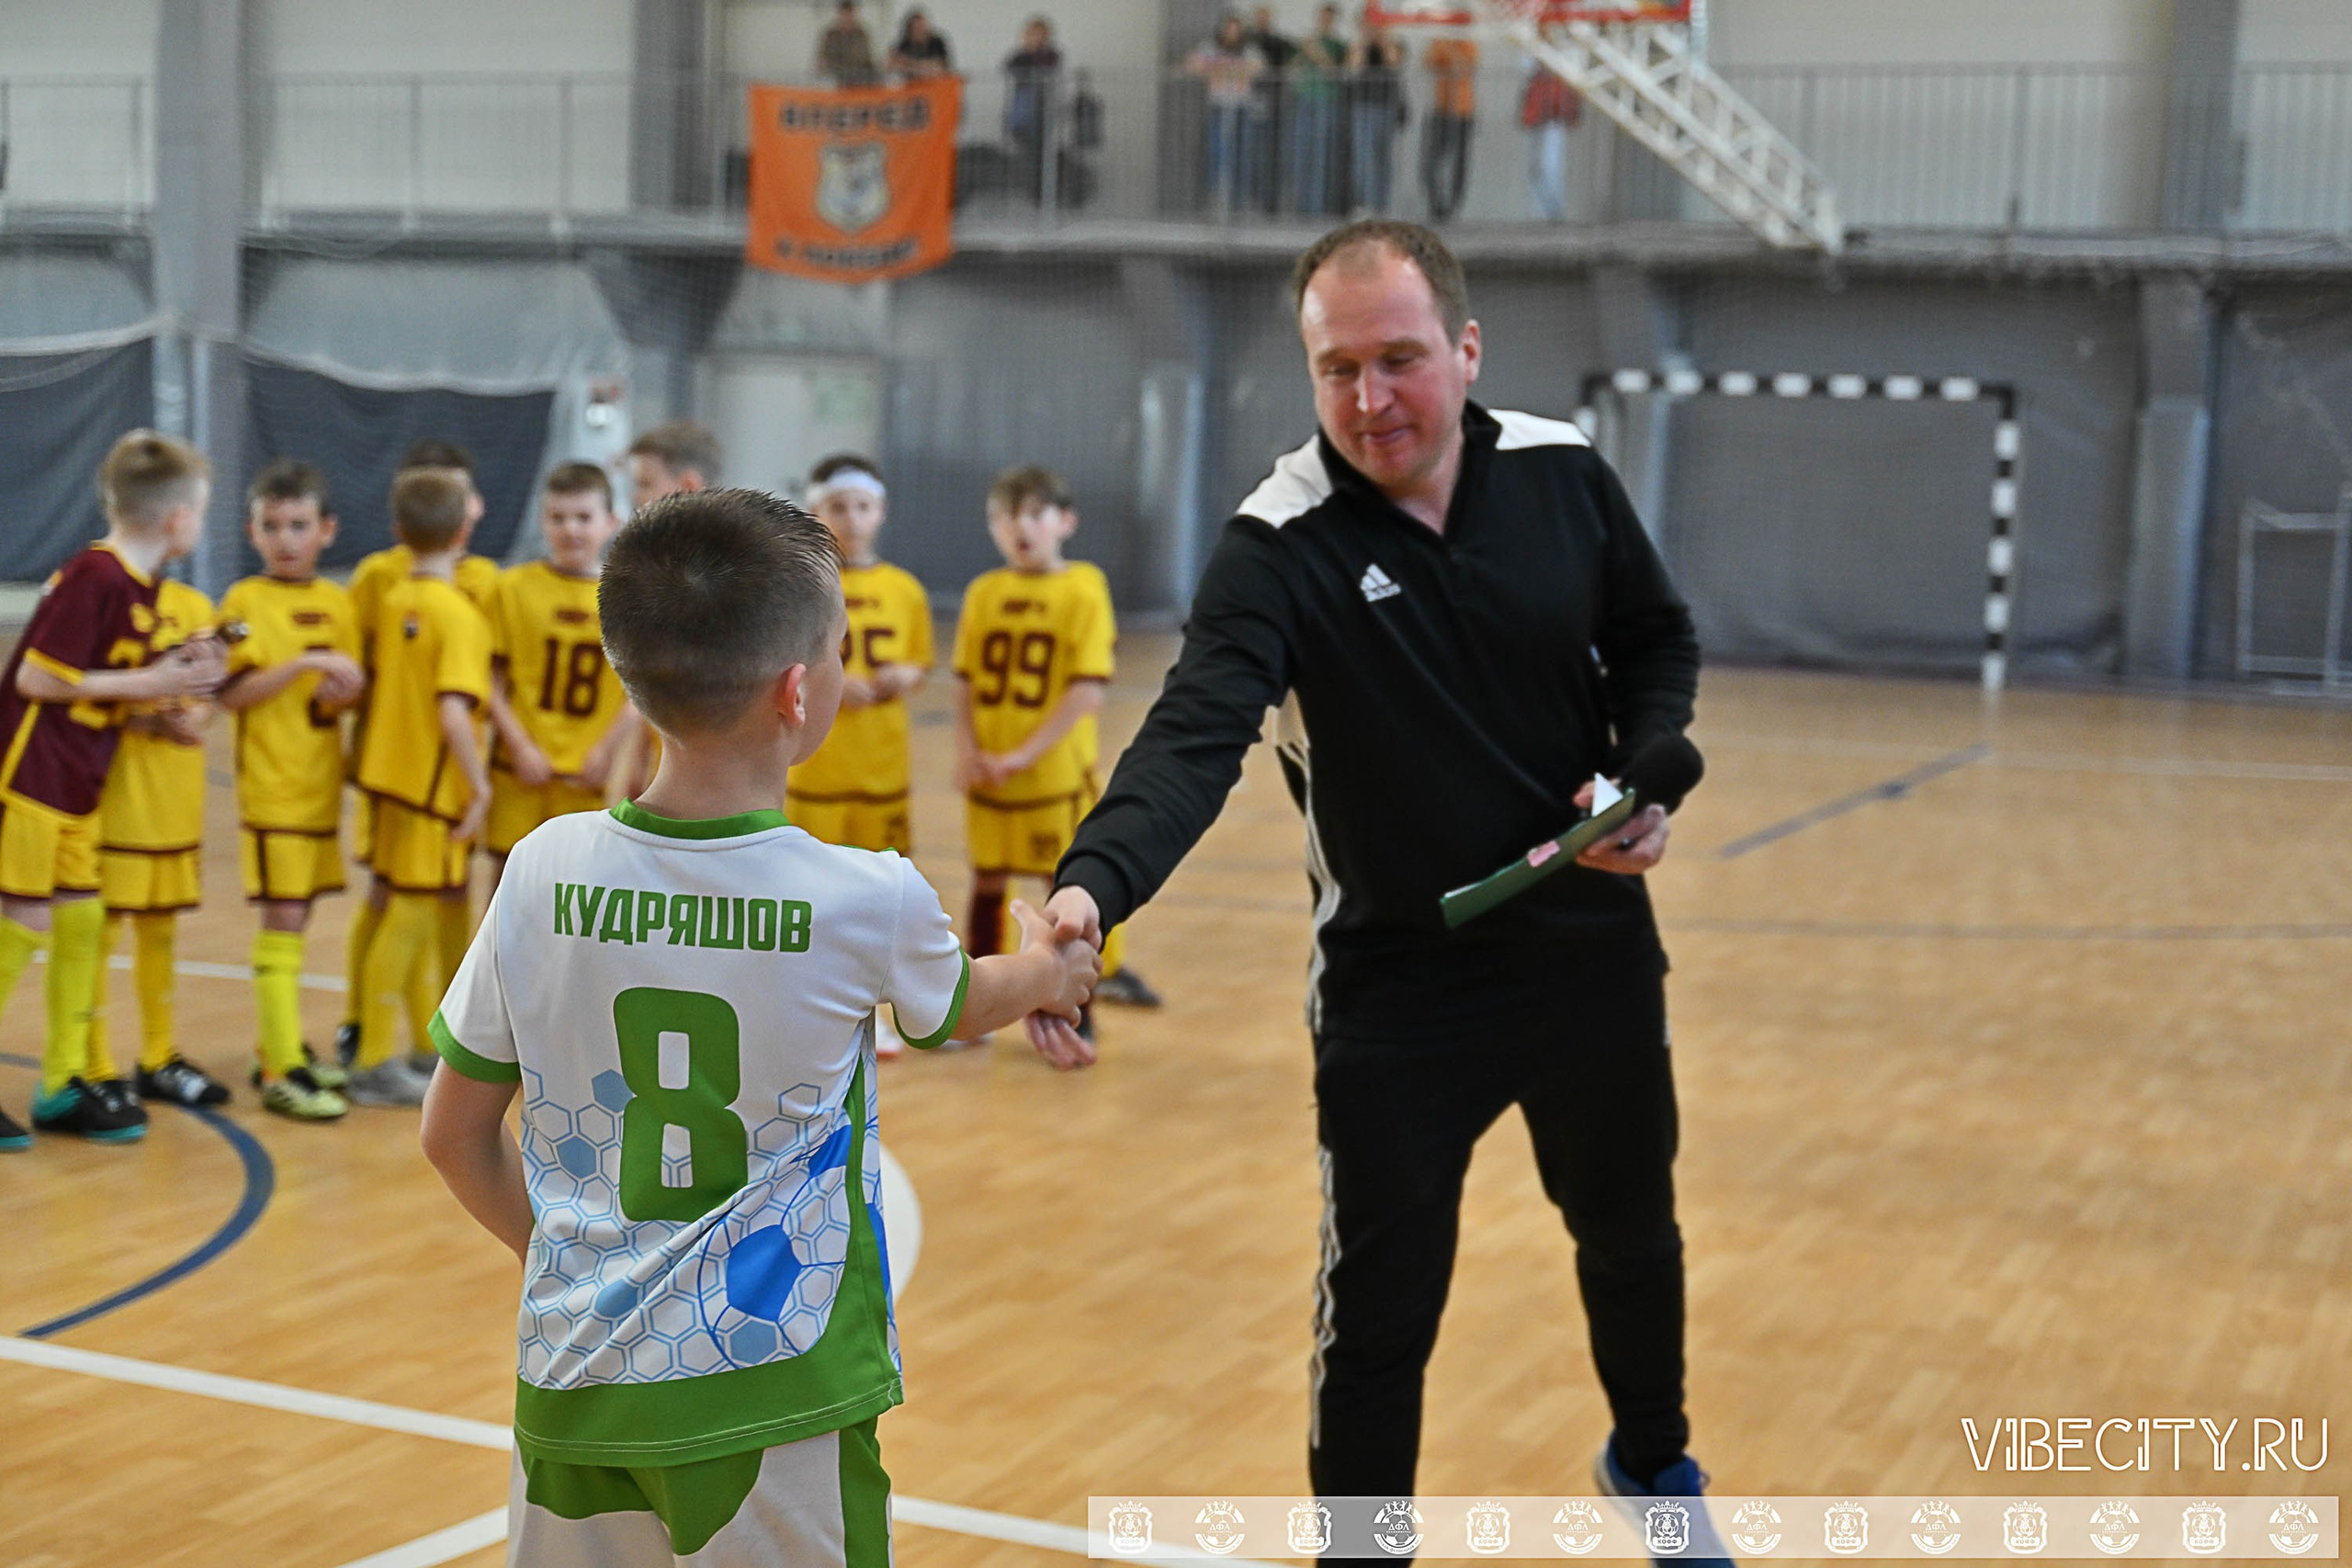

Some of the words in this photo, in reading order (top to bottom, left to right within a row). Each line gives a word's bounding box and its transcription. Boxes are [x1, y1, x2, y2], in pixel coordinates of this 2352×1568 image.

[538, 636, 605, 717] 18
[979, 630, 1056, 707] 99
[553, 882, 813, 953] КУДРЯШОВ
[612, 986, 749, 1223] 8
